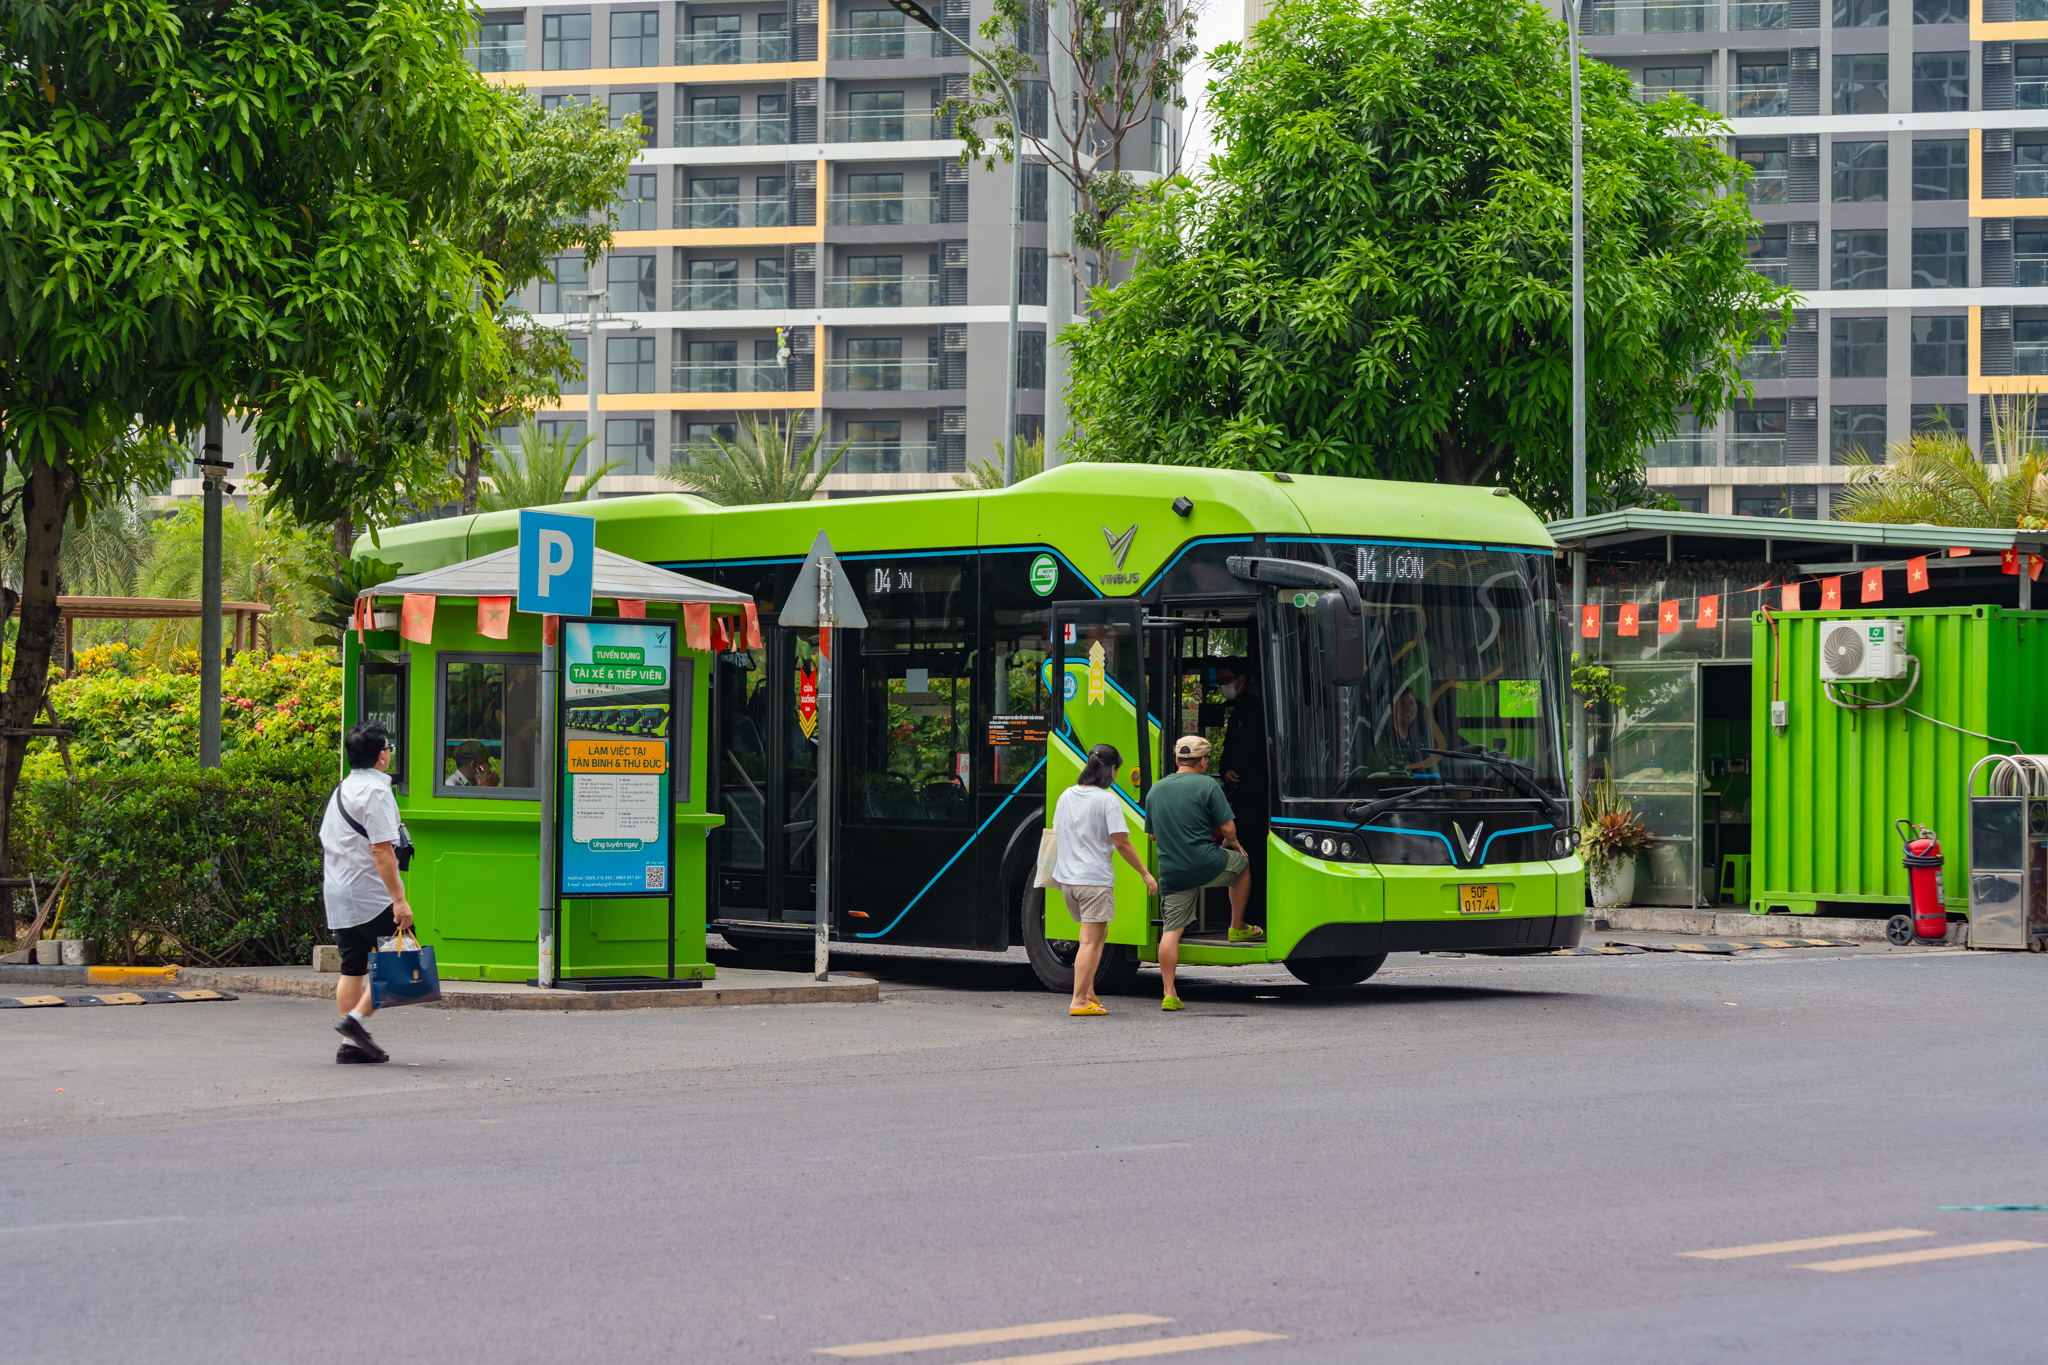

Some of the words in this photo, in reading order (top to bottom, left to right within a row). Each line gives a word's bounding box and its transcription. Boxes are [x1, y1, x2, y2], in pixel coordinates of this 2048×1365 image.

[537, 528, 574, 598] P
[1357, 547, 1377, 581] D4
[874, 567, 891, 593] D4
[1099, 572, 1140, 586] VINBUS
[620, 651, 641, 661] DỤNG
[573, 667, 589, 678] TÀI
[592, 666, 605, 679] XẾ
[607, 670, 614, 679] &
[616, 667, 637, 679] TIẾP
[639, 669, 662, 680] VIÊN
[588, 744, 608, 755] LÀM
[610, 744, 631, 757] VIỆC
[632, 747, 646, 757] TẠI
[571, 756, 589, 767] TÂN
[591, 757, 613, 767] BÌNH
[614, 759, 621, 768] &
[622, 756, 641, 768] THỦ
[642, 757, 662, 768] ĐỨC
[592, 840, 606, 849] Ứng
[1470, 886, 1488, 898] 50F
[1465, 899, 1496, 912] 017.44
